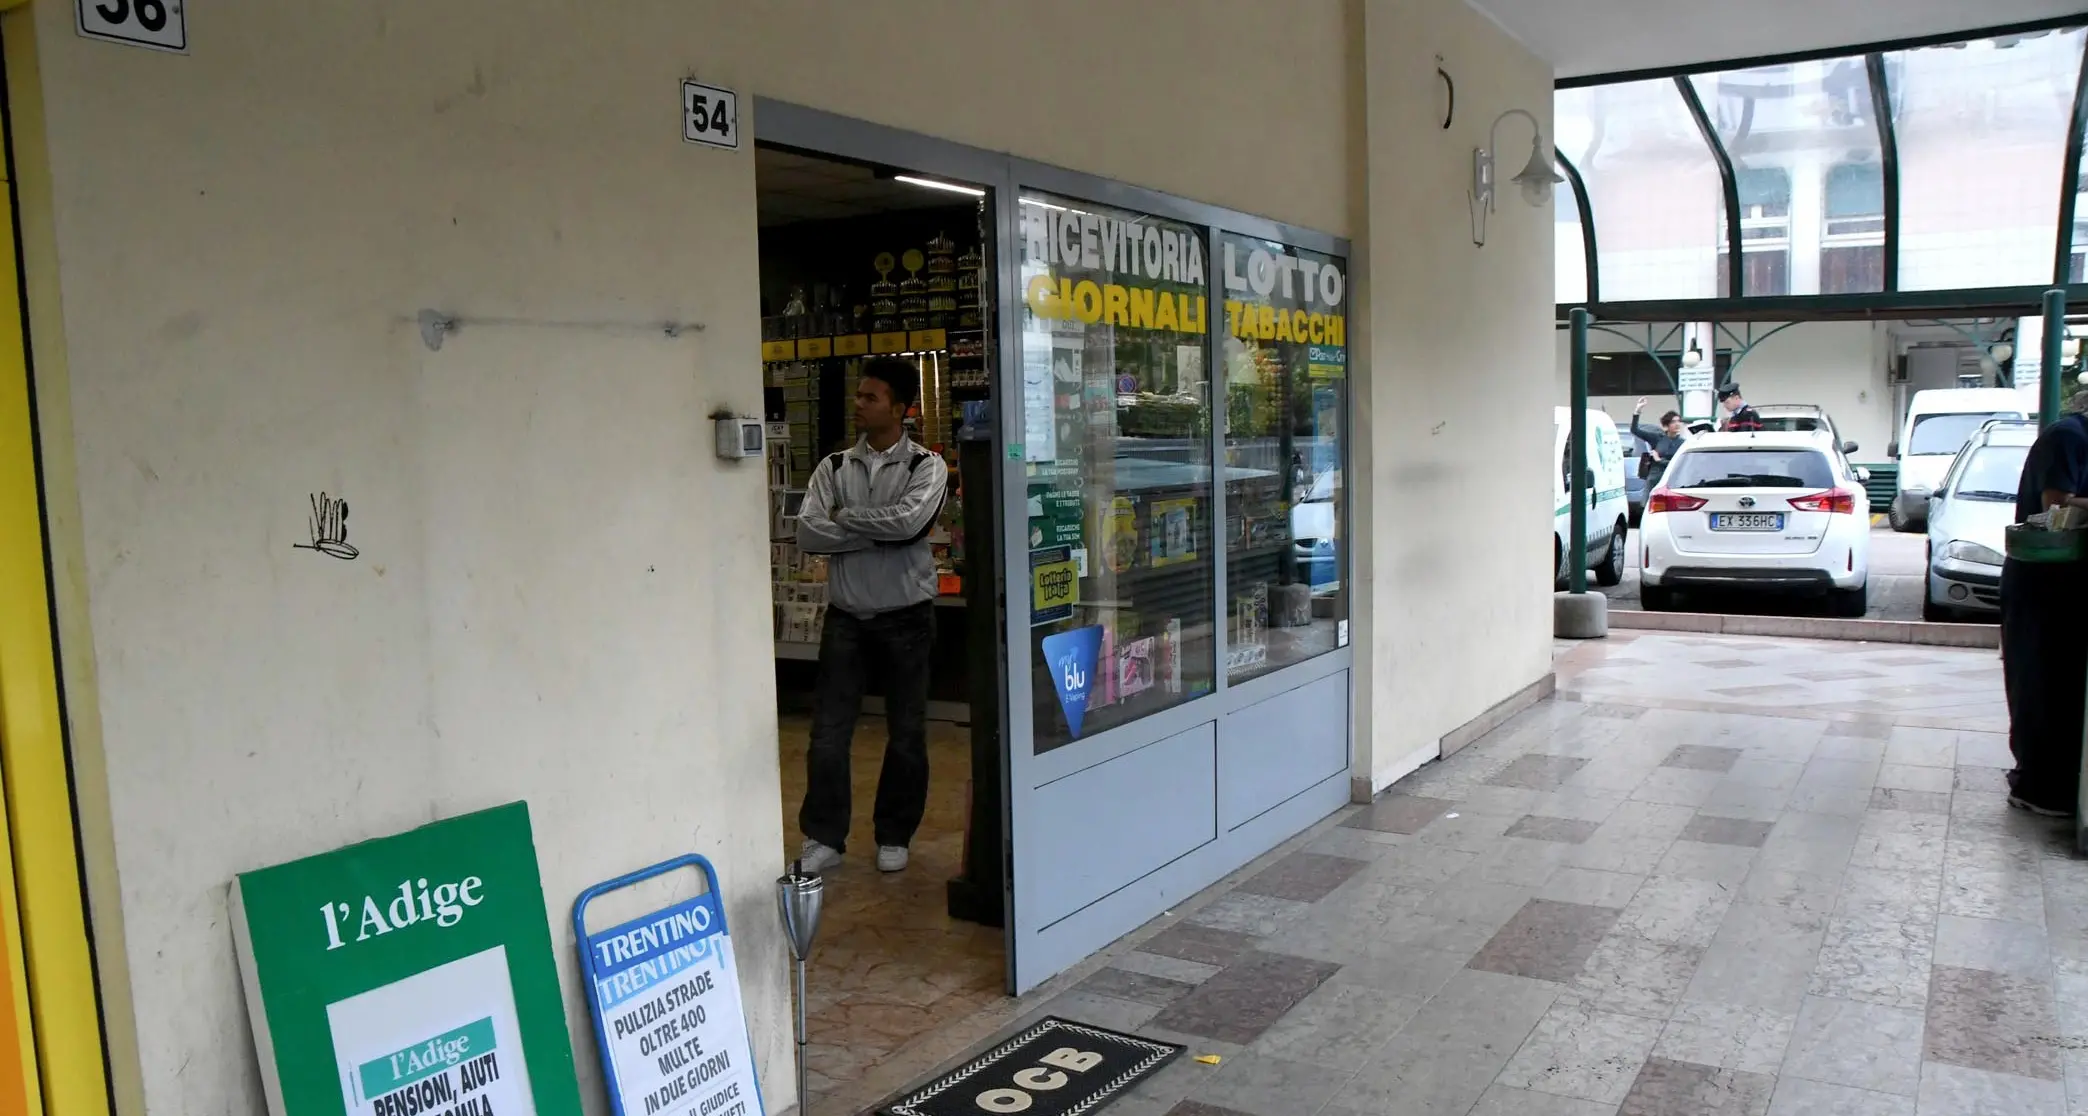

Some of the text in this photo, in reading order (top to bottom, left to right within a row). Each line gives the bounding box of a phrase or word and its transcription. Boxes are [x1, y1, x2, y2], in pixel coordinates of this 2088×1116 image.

[693, 94, 729, 136] 54
[1026, 204, 1204, 285] RICEVITORIA
[1224, 242, 1342, 306] LOTTO
[1028, 275, 1206, 334] GIORNALI
[1225, 301, 1345, 346] TABACCHI
[1719, 516, 1774, 527] EX 336HC
[1065, 662, 1085, 690] blu
[320, 876, 484, 950] l'Adige
[596, 905, 711, 967] TRENTINO
[600, 938, 707, 1004] TRENTINO
[613, 970, 714, 1040] PULIZIA STRADE
[639, 1005, 706, 1057] OLTRE 400
[373, 1052, 500, 1116] PENSIONI, AIUTI
[390, 1035, 469, 1080] l'Adige
[644, 1050, 731, 1115] IN DUE GIORNI
[658, 1037, 703, 1076] MULTE
[976, 1047, 1103, 1113] OCB
[700, 1082, 740, 1116] GIUDICE
